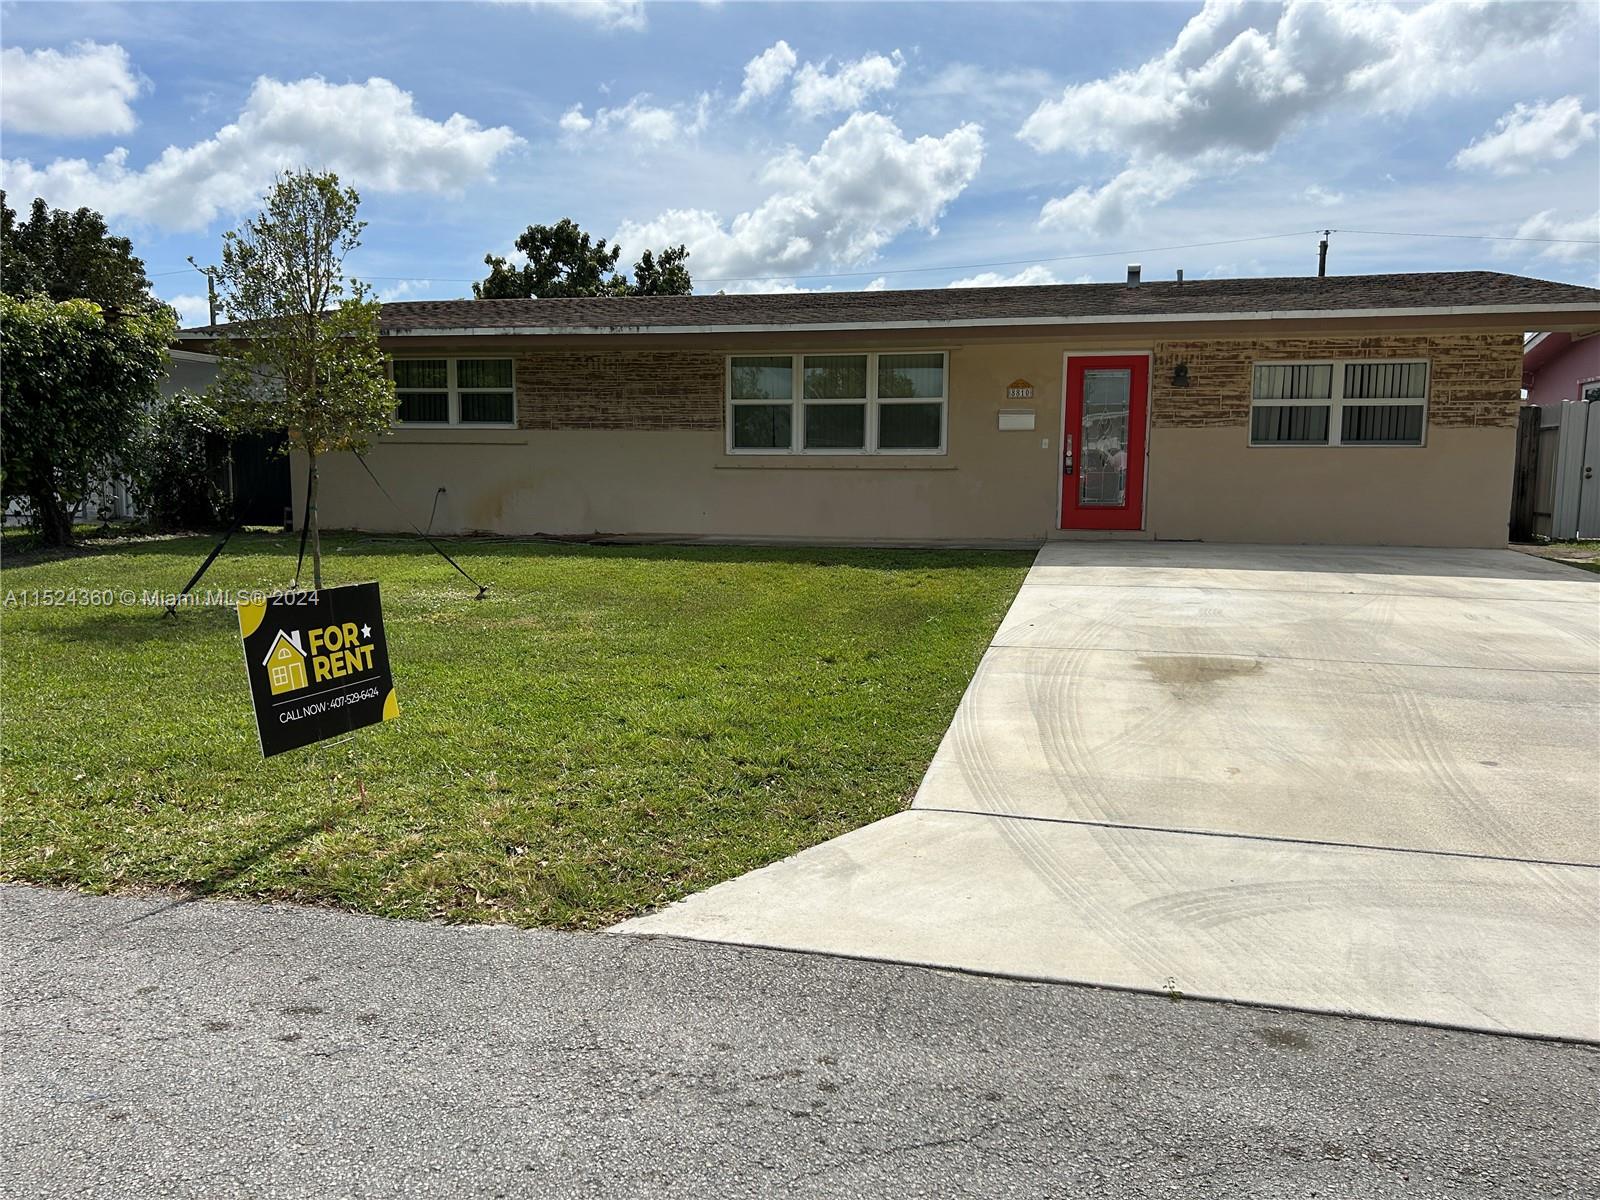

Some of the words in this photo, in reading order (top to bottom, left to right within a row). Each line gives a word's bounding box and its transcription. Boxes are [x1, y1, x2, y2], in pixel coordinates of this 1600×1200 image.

[308, 622, 360, 656] FOR
[312, 644, 375, 683] RENT
[279, 708, 303, 724] CALL
[303, 701, 326, 717] NOW
[330, 687, 379, 709] 407-529-6424
